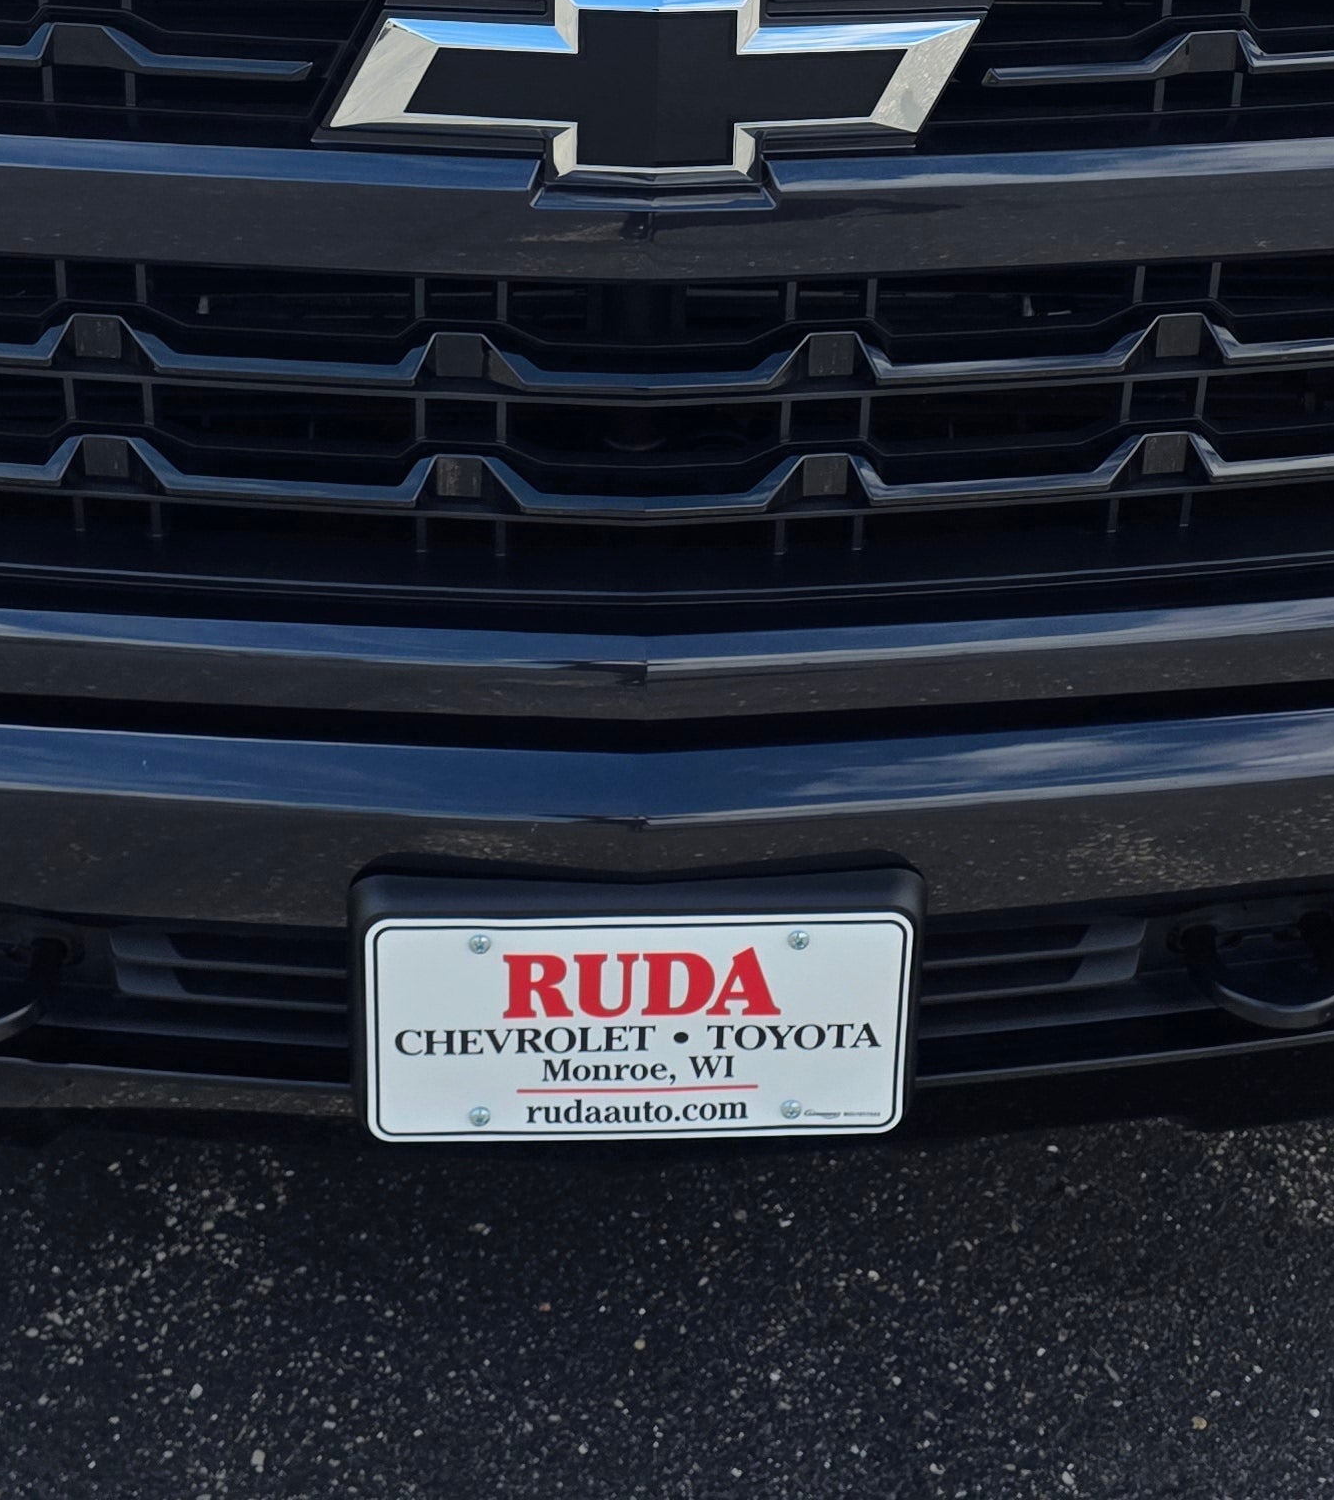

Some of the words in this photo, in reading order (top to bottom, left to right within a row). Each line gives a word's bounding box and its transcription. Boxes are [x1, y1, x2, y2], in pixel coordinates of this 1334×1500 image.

[502, 946, 781, 1019] RUDA
[394, 1024, 656, 1056] CHEVROLET
[707, 1022, 881, 1051] TOYOTA
[542, 1057, 677, 1085] Monroe,
[689, 1055, 736, 1079] WI
[525, 1099, 749, 1125] rudaauto.com
